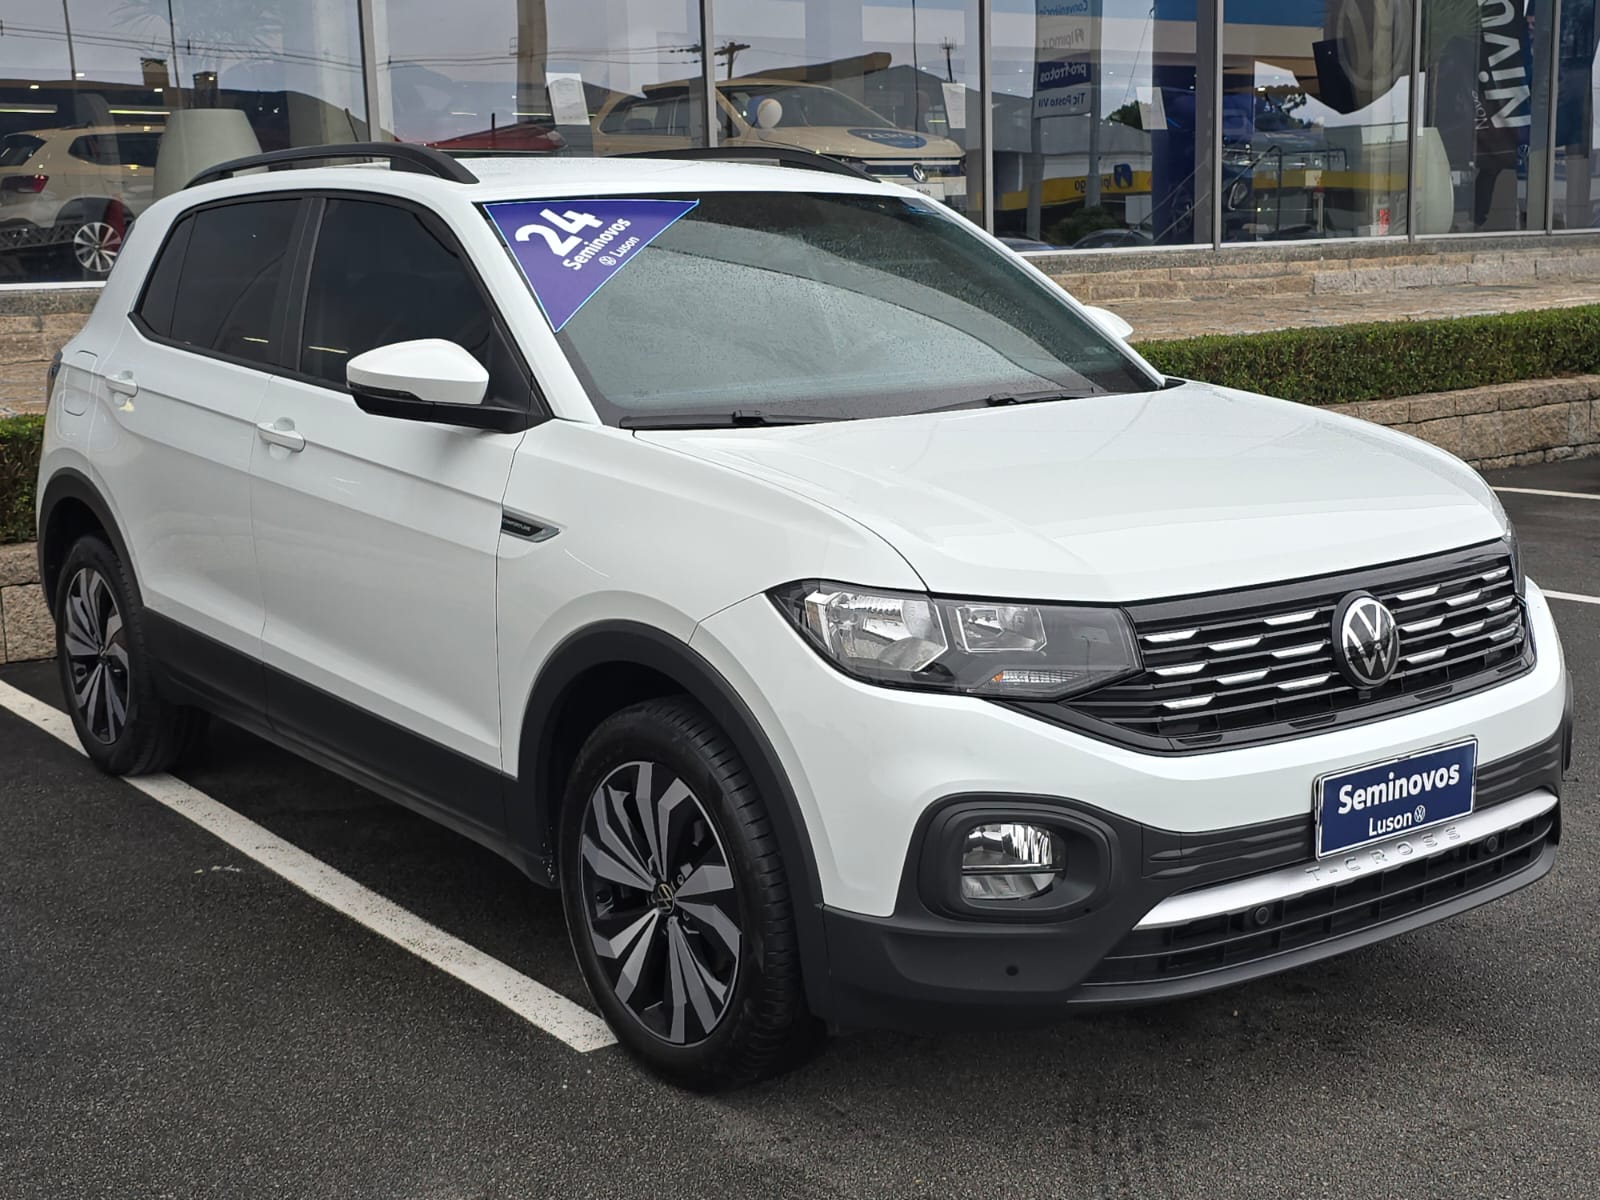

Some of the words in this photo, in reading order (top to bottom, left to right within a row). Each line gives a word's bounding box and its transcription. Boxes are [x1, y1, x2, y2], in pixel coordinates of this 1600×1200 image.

[515, 208, 603, 257] 24
[562, 218, 631, 270] Seminovos
[609, 236, 640, 257] Luson
[1337, 764, 1460, 815] Seminovos
[1368, 812, 1412, 837] Luson
[1305, 826, 1461, 882] T-CROSS
